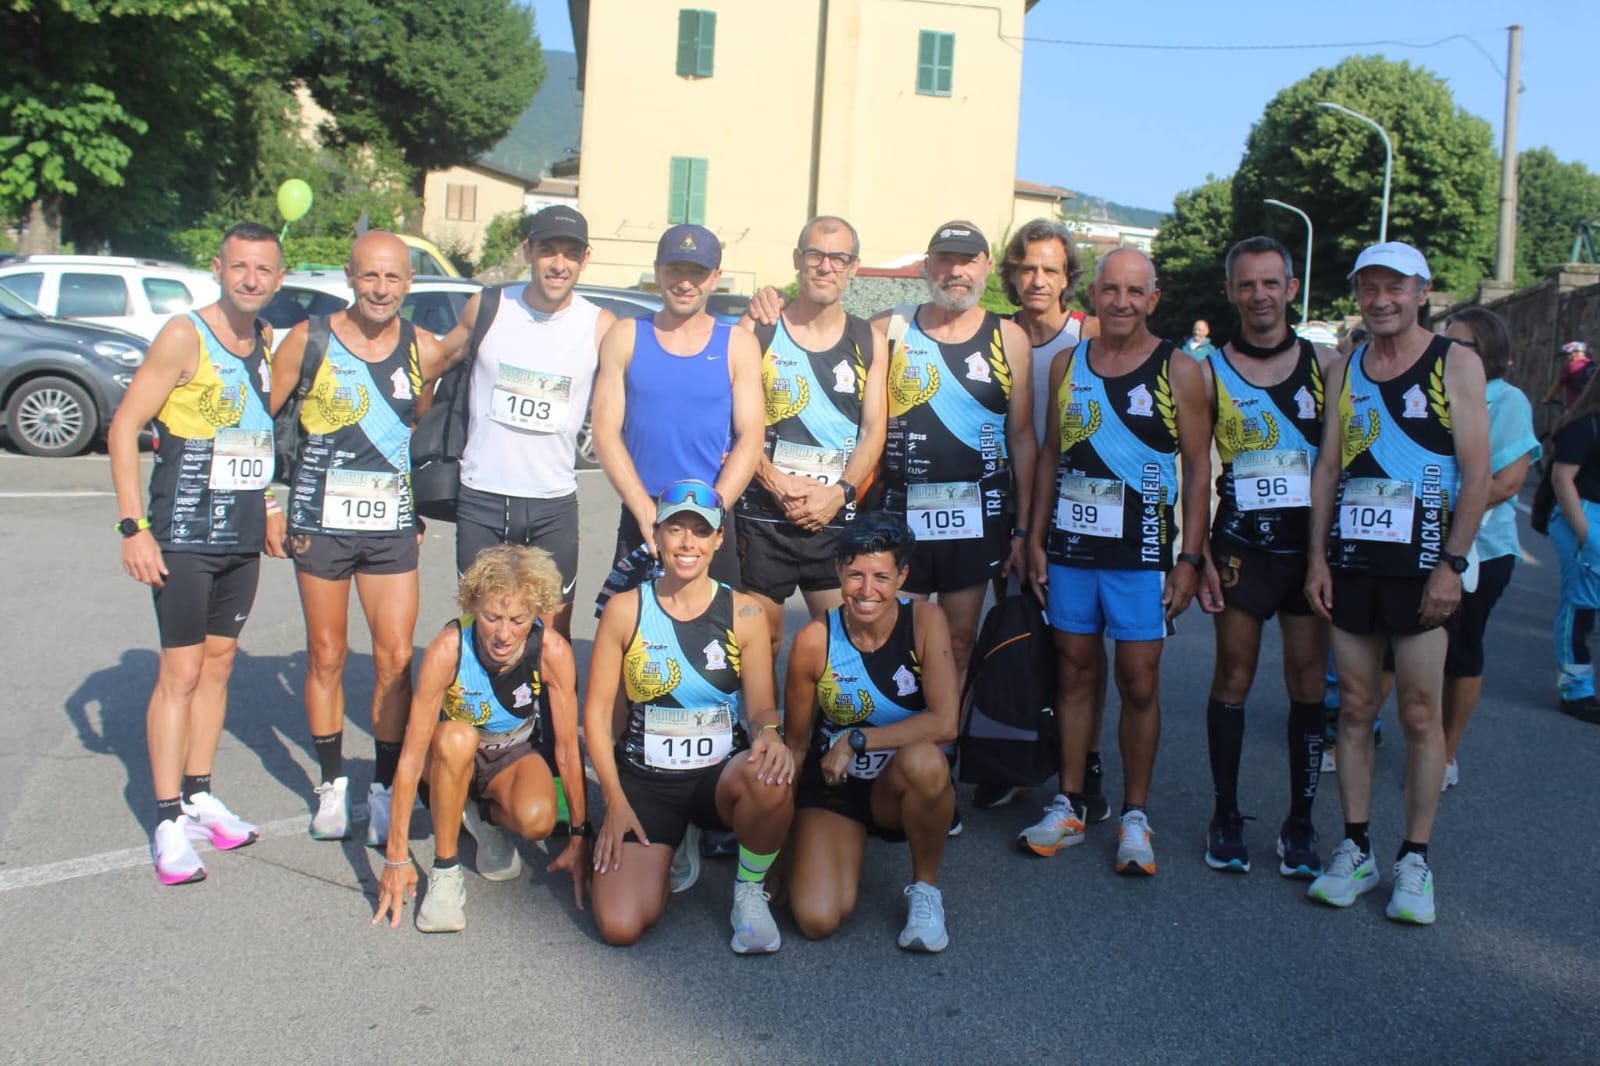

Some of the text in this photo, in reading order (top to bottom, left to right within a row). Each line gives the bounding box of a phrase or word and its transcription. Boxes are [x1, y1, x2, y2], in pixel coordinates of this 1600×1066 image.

[506, 396, 551, 420] 103
[227, 458, 263, 478] 100
[1256, 478, 1288, 497] 96
[342, 499, 386, 519] 109
[1072, 504, 1098, 523] 99
[1350, 508, 1392, 528] 104
[921, 510, 965, 528] 105
[662, 738, 713, 757] 110
[855, 753, 888, 771] 97
